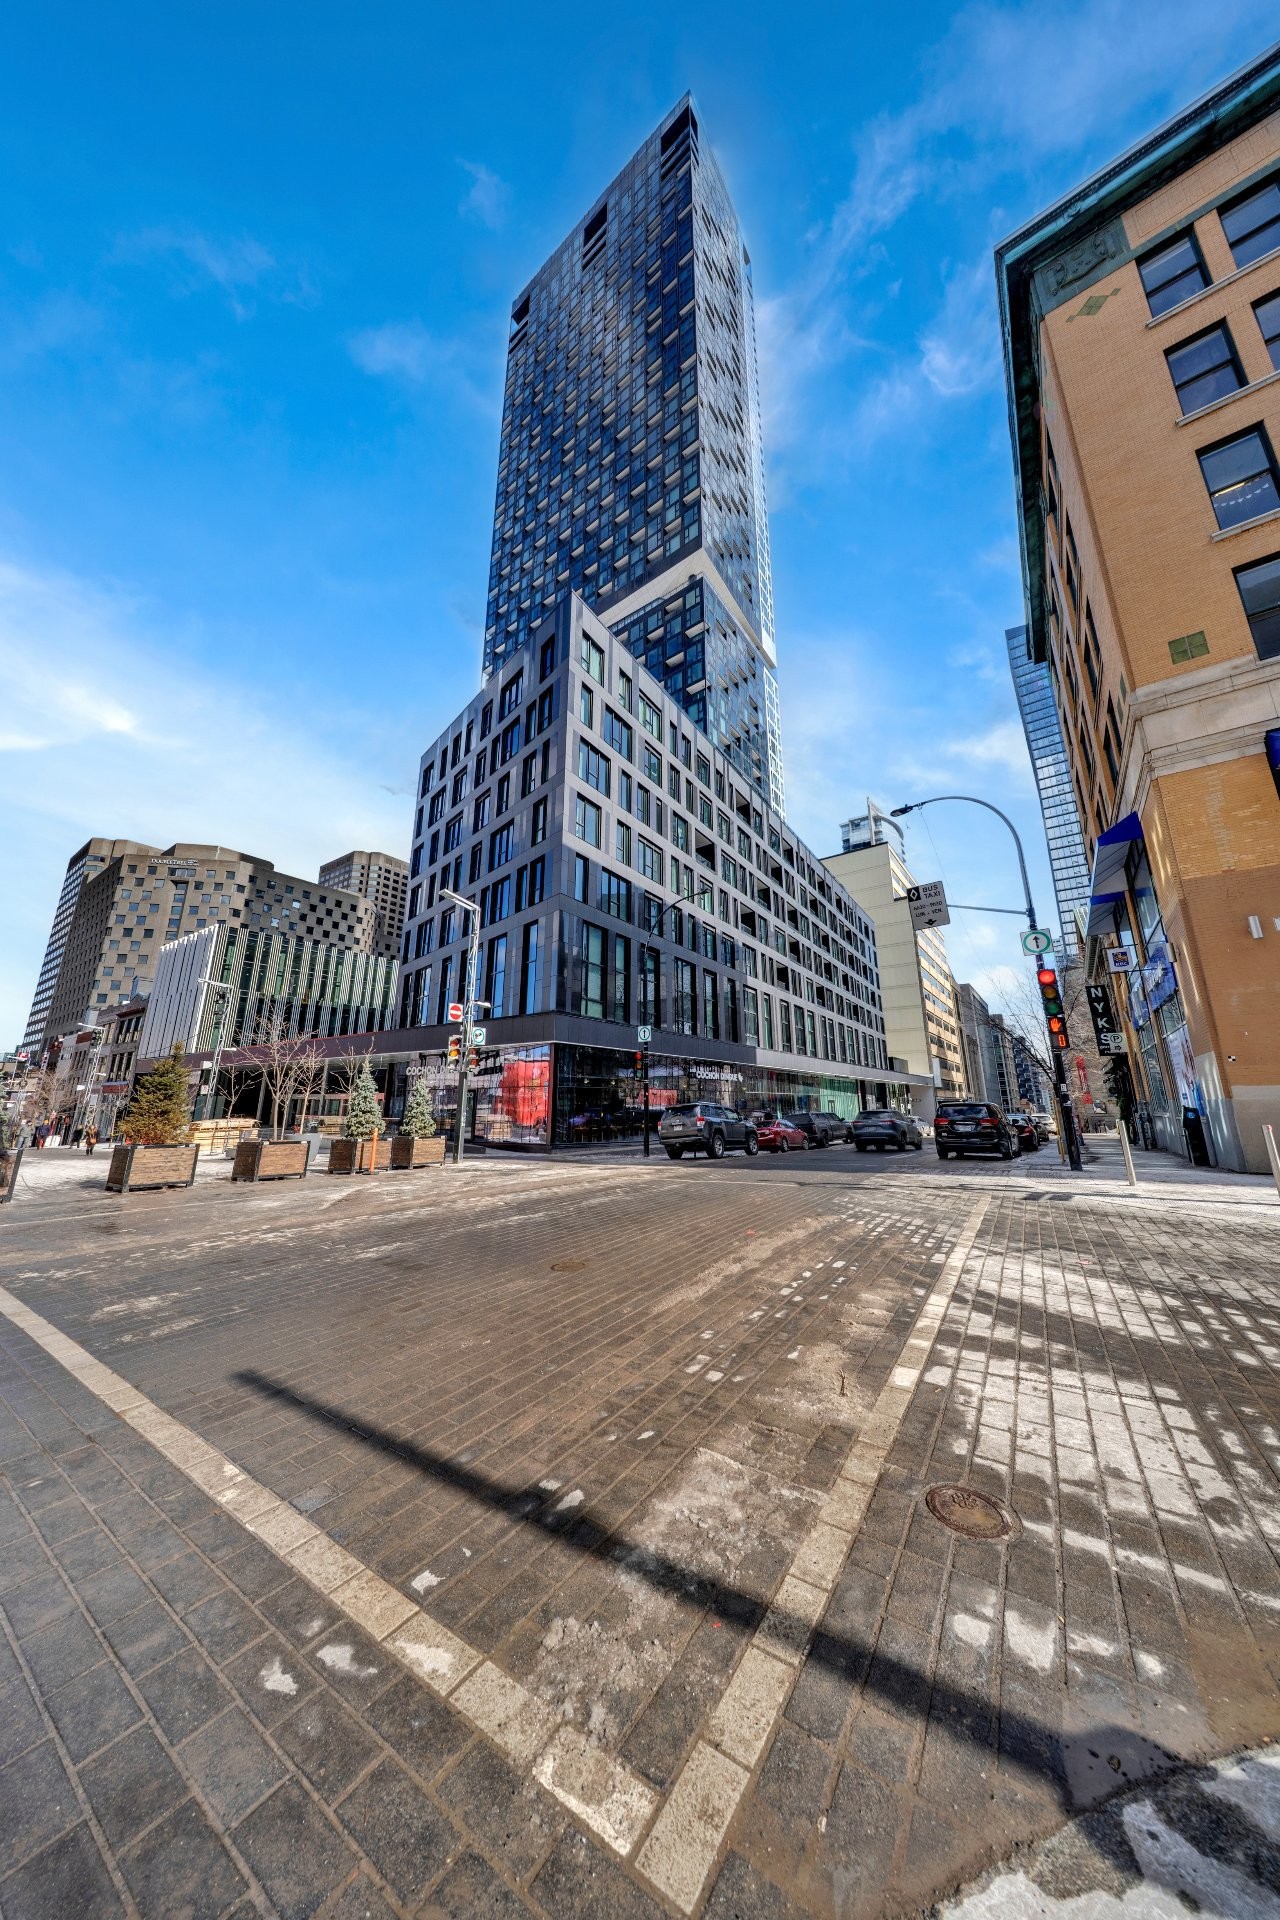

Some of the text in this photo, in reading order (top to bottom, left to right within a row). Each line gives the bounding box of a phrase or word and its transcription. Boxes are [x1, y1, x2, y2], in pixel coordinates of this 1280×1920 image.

[922, 884, 938, 893] BUS
[924, 890, 941, 899] TAXI
[406, 1066, 437, 1075] COCHON
[696, 1071, 738, 1081] COCHON DINGUE
